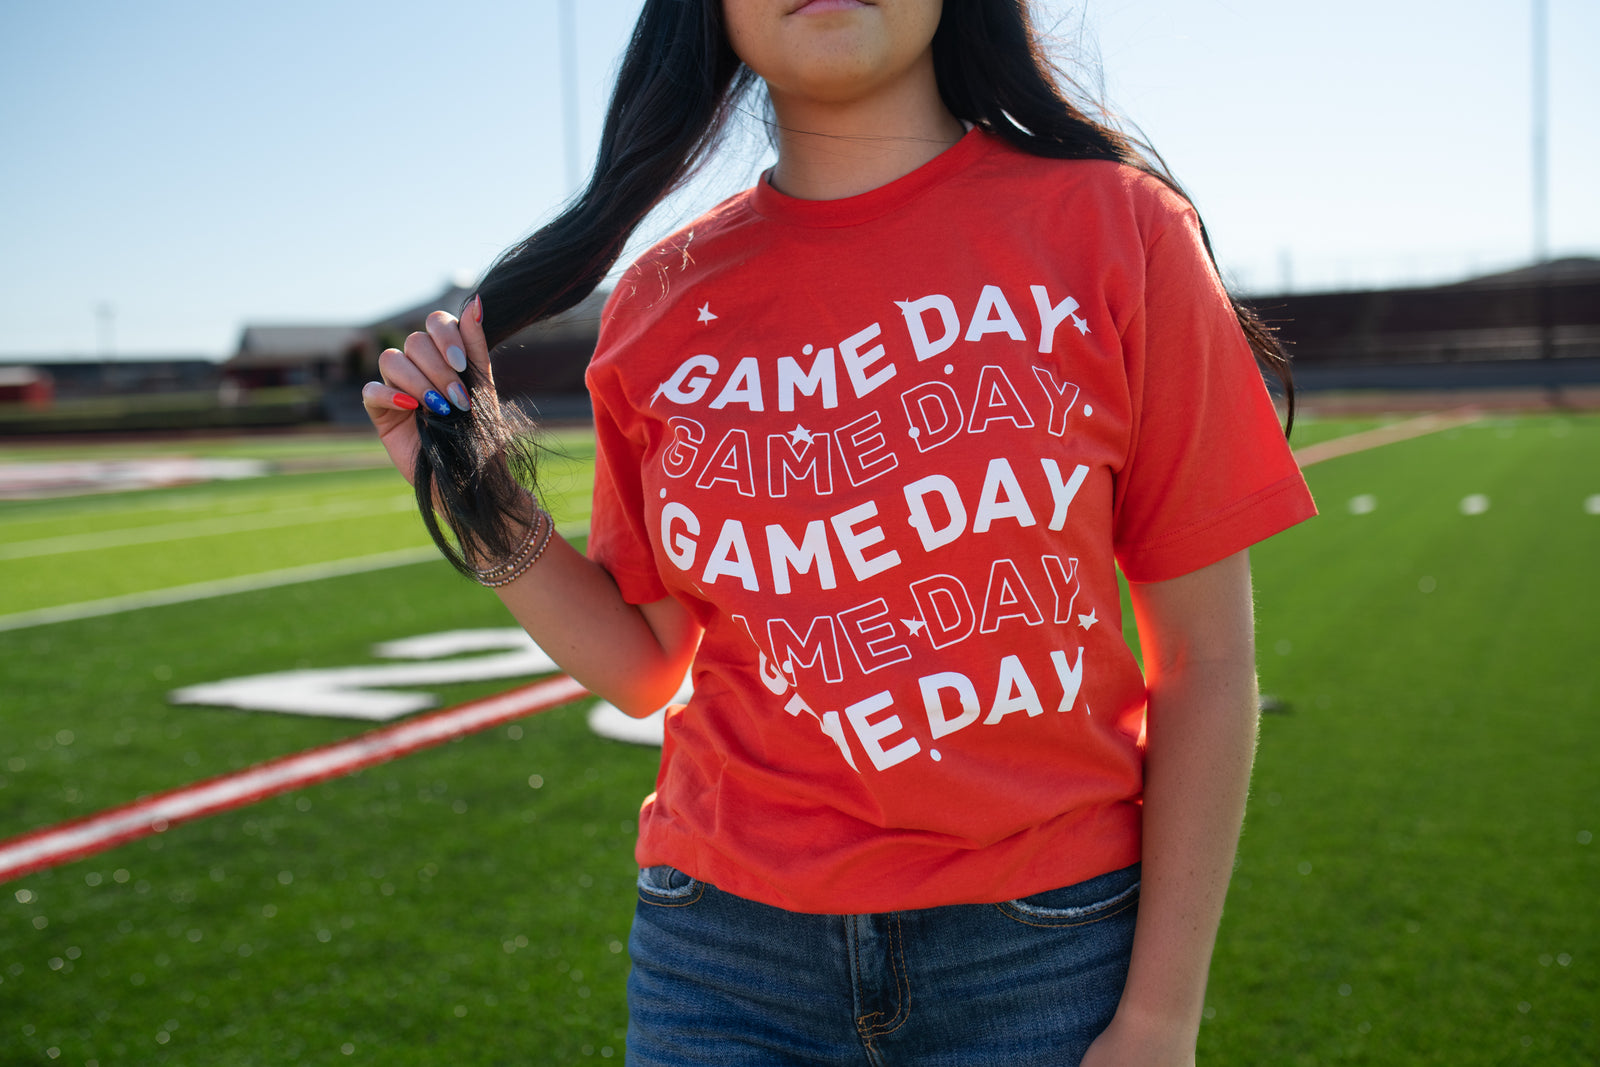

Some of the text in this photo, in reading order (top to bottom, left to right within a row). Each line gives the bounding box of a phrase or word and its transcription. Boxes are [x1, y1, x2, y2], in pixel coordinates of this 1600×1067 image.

[662, 285, 1081, 413] GAME DAY
[661, 365, 1080, 498] GAME DAY
[660, 457, 1090, 595] GAME DAY
[732, 555, 1081, 687] ME DAY
[918, 646, 1086, 740] DAY
